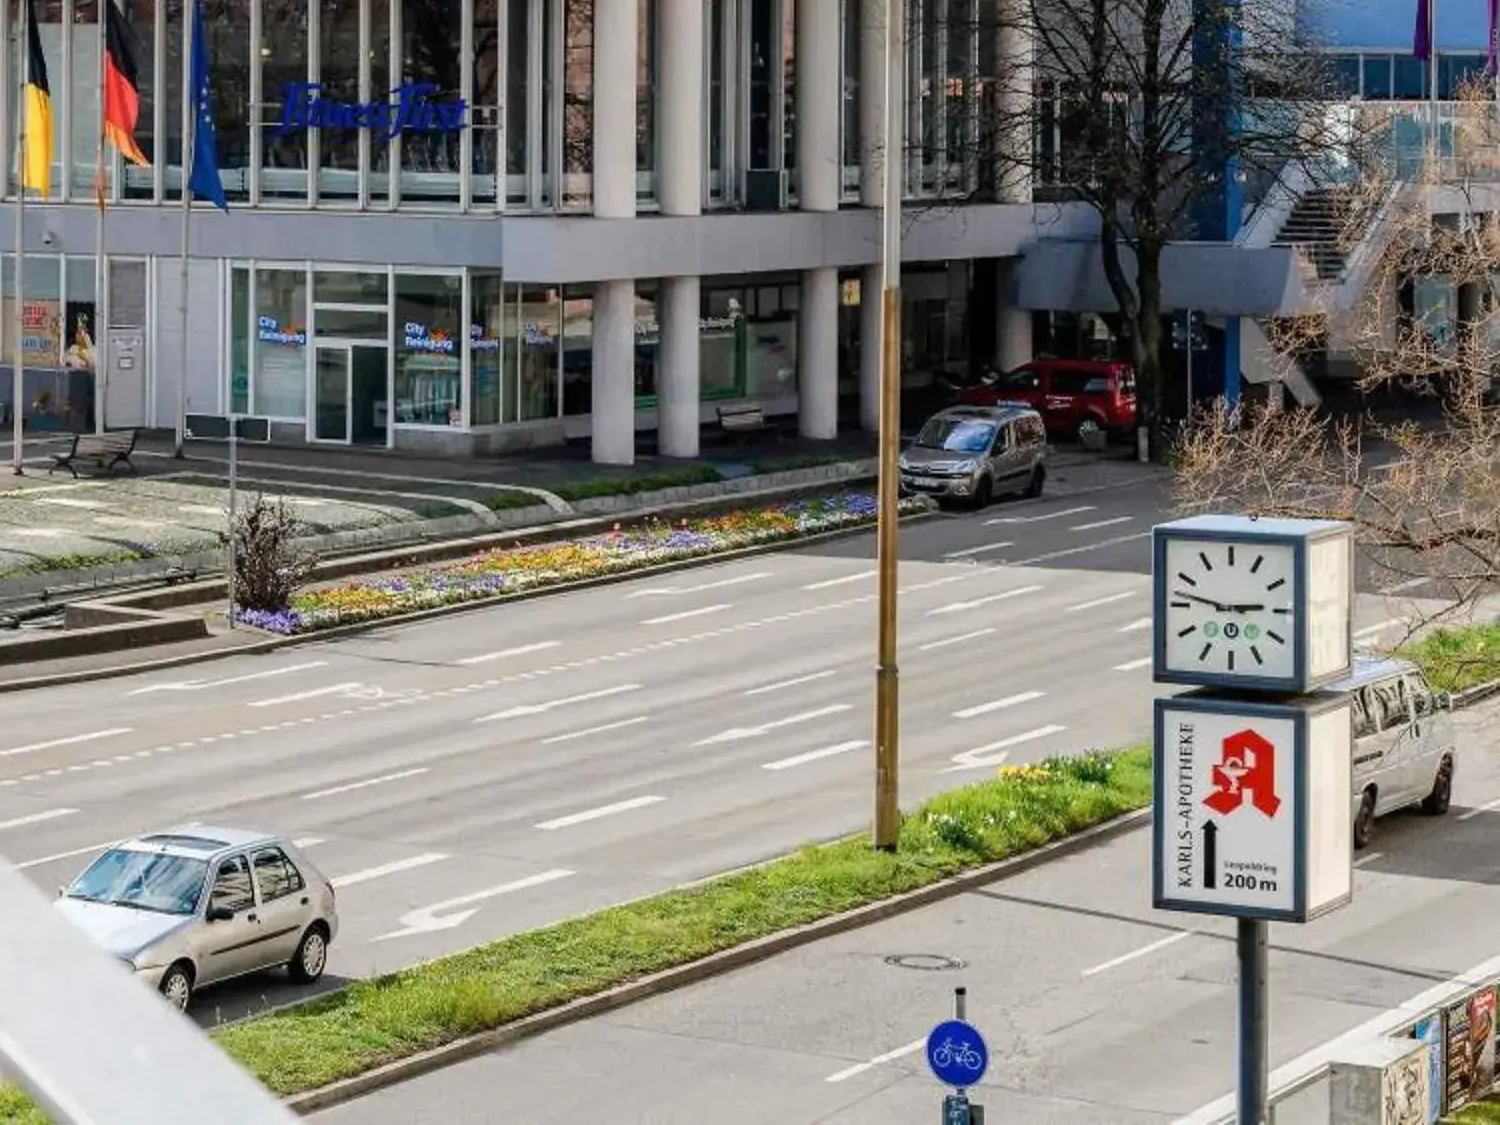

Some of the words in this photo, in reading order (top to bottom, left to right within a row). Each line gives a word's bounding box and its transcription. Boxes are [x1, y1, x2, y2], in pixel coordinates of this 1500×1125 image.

[405, 322, 426, 335] City
[1177, 722, 1194, 888] KARLS-APOTHEKE
[1224, 873, 1257, 890] 200
[1259, 880, 1277, 892] m
